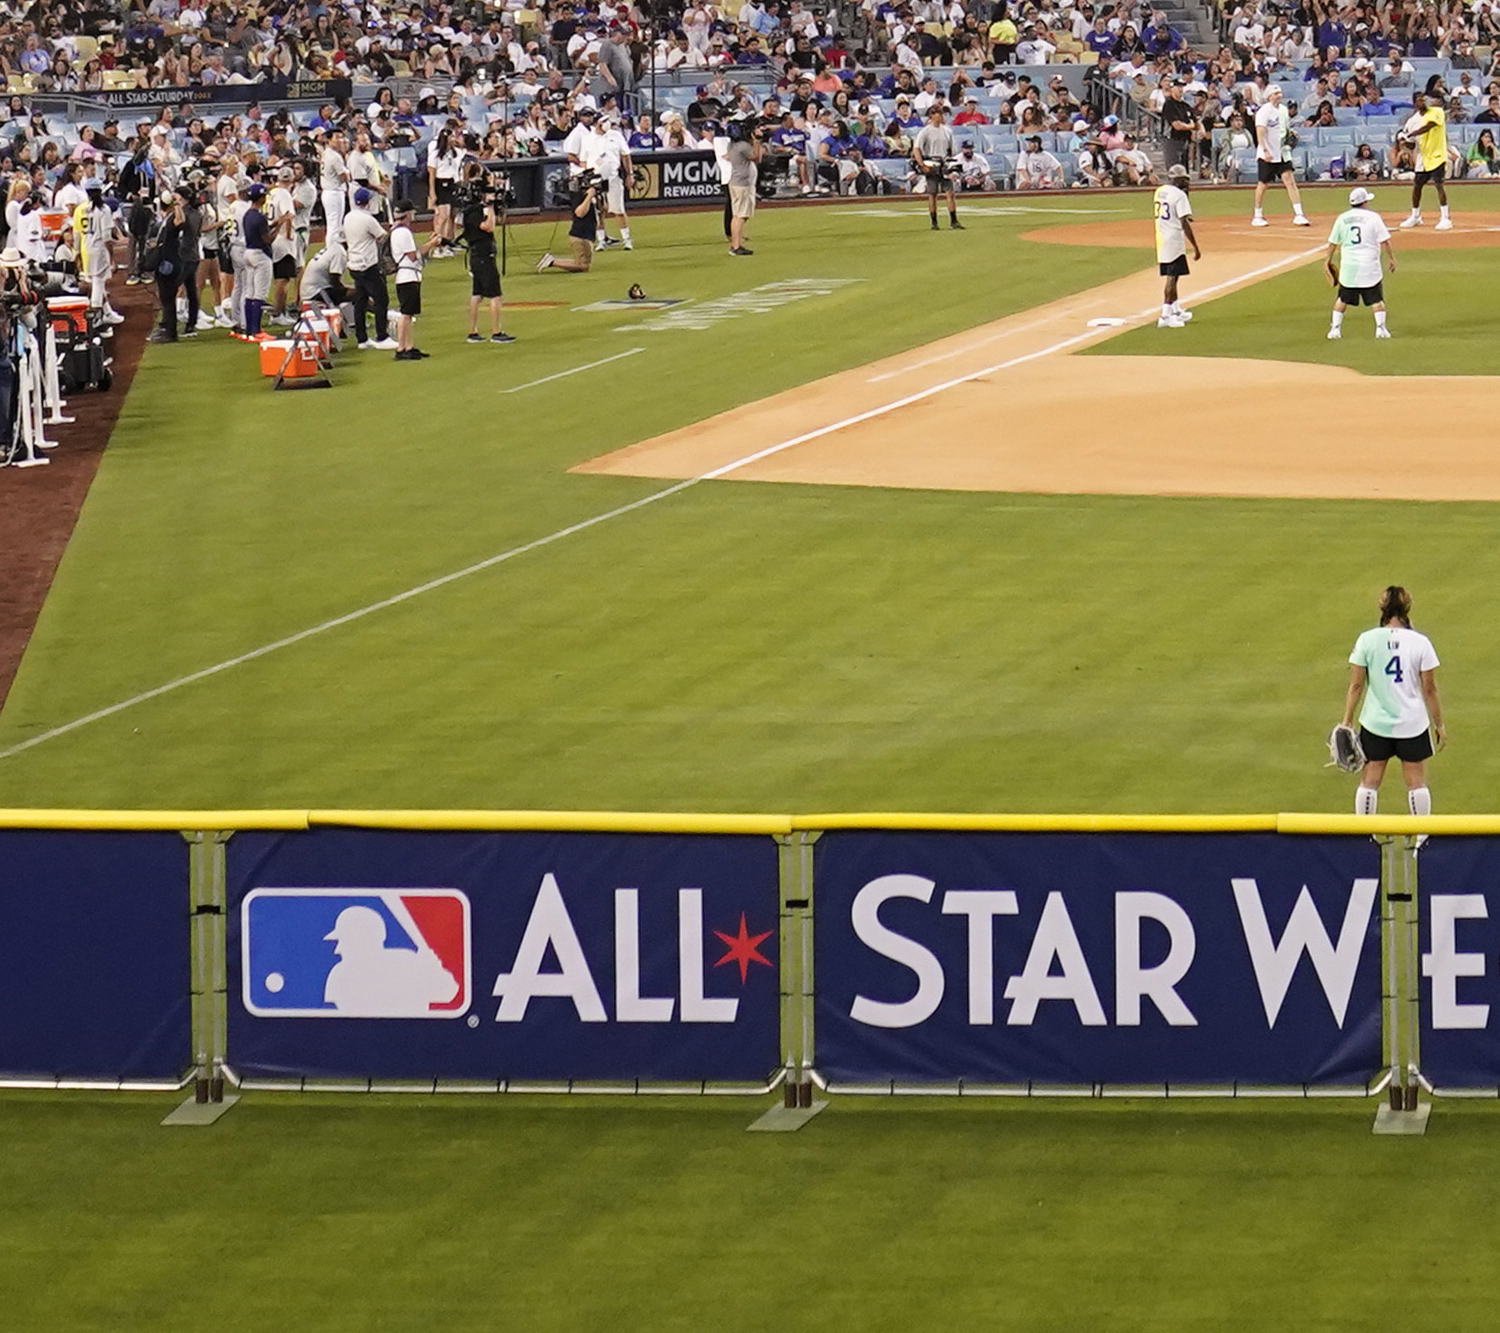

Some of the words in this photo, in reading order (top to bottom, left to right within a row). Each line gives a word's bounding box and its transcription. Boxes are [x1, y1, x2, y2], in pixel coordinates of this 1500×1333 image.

[108, 93, 124, 106] ALL
[126, 92, 147, 105] STAR
[148, 90, 194, 104] SATURDAY
[300, 83, 326, 94] MGM
[664, 162, 720, 183] MGM
[663, 183, 721, 198] REWARDS
[1350, 225, 1362, 245] 3
[1385, 655, 1403, 684] 4
[492, 873, 740, 1023] ALL
[850, 874, 1198, 1028] STAR
